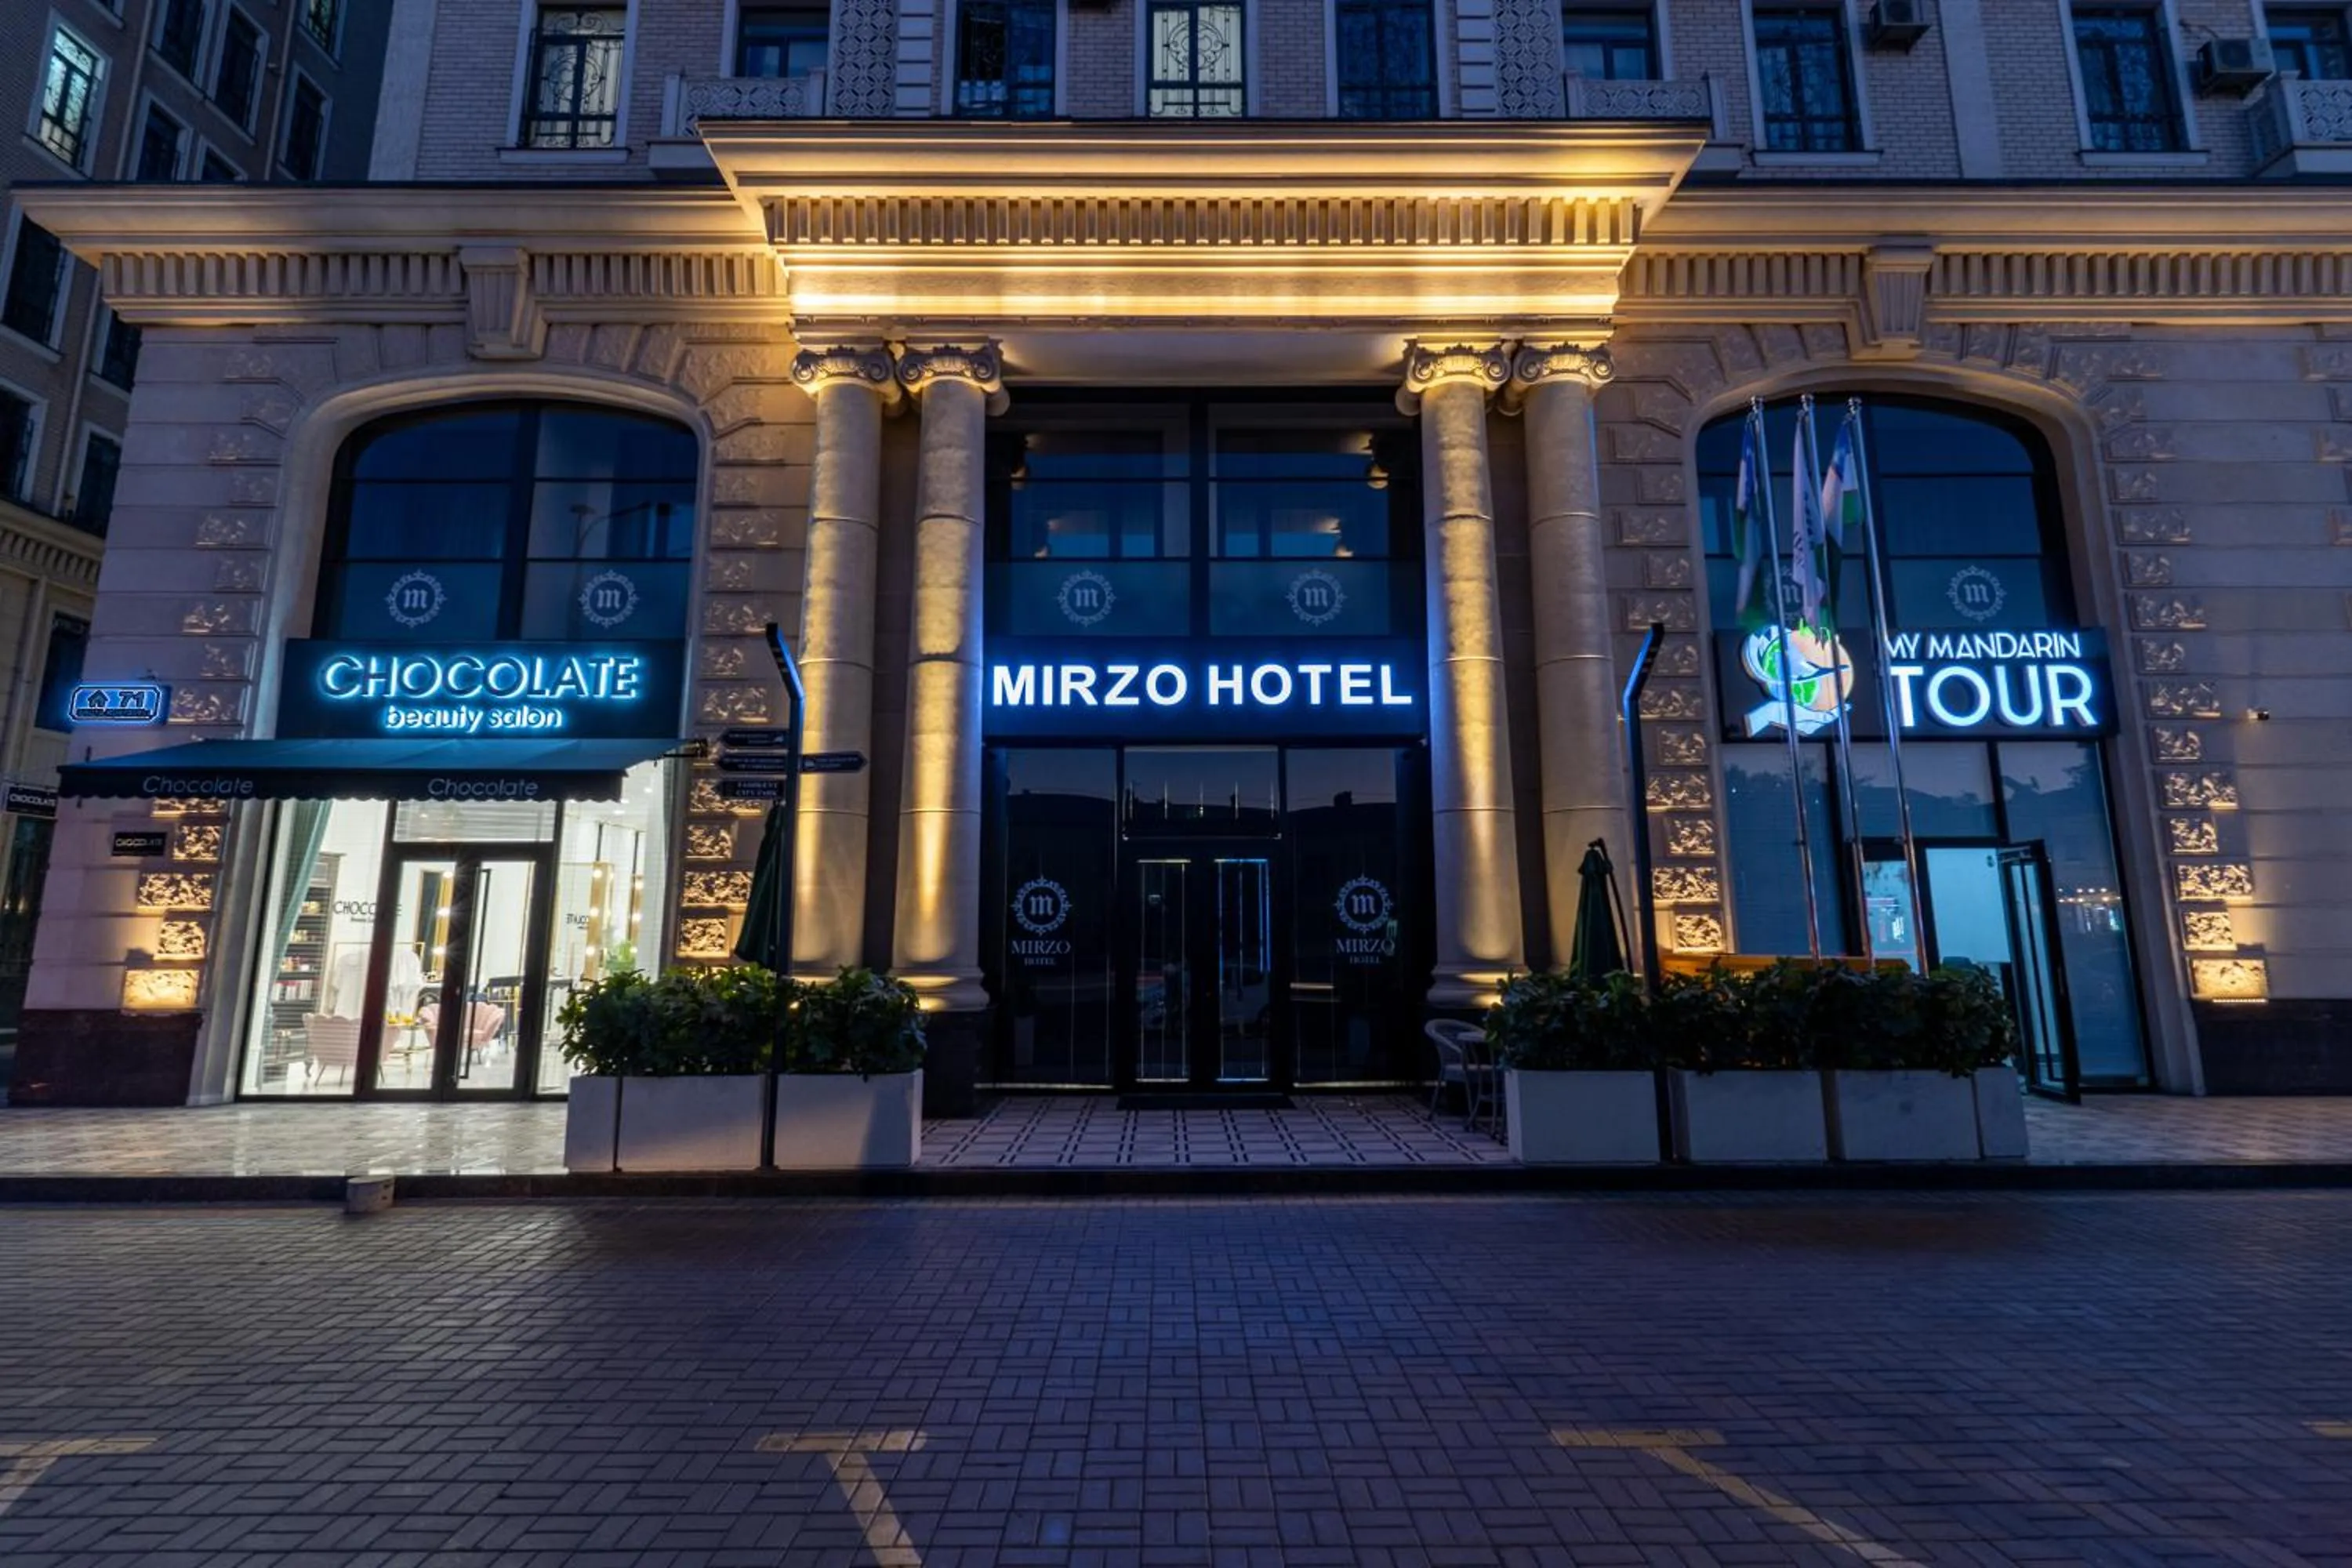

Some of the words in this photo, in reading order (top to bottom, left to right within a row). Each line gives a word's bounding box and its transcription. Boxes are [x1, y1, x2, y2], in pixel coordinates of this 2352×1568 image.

[1929, 632, 2082, 659] MANDARIN
[322, 655, 640, 699] CHOCOLATE
[993, 664, 1188, 706] MIRZO
[1208, 664, 1412, 705] HOTEL
[118, 691, 144, 707] 71
[1889, 665, 2098, 727] TOUR
[386, 705, 483, 732] beauty
[488, 706, 564, 728] salon
[143, 775, 254, 795] Chocolate
[426, 776, 539, 797] Chocolate
[9, 793, 56, 807] CHOCOLATE
[1011, 940, 1071, 954] MIRZO
[1336, 938, 1396, 953] MIRZO
[1024, 957, 1056, 966] HOTEL
